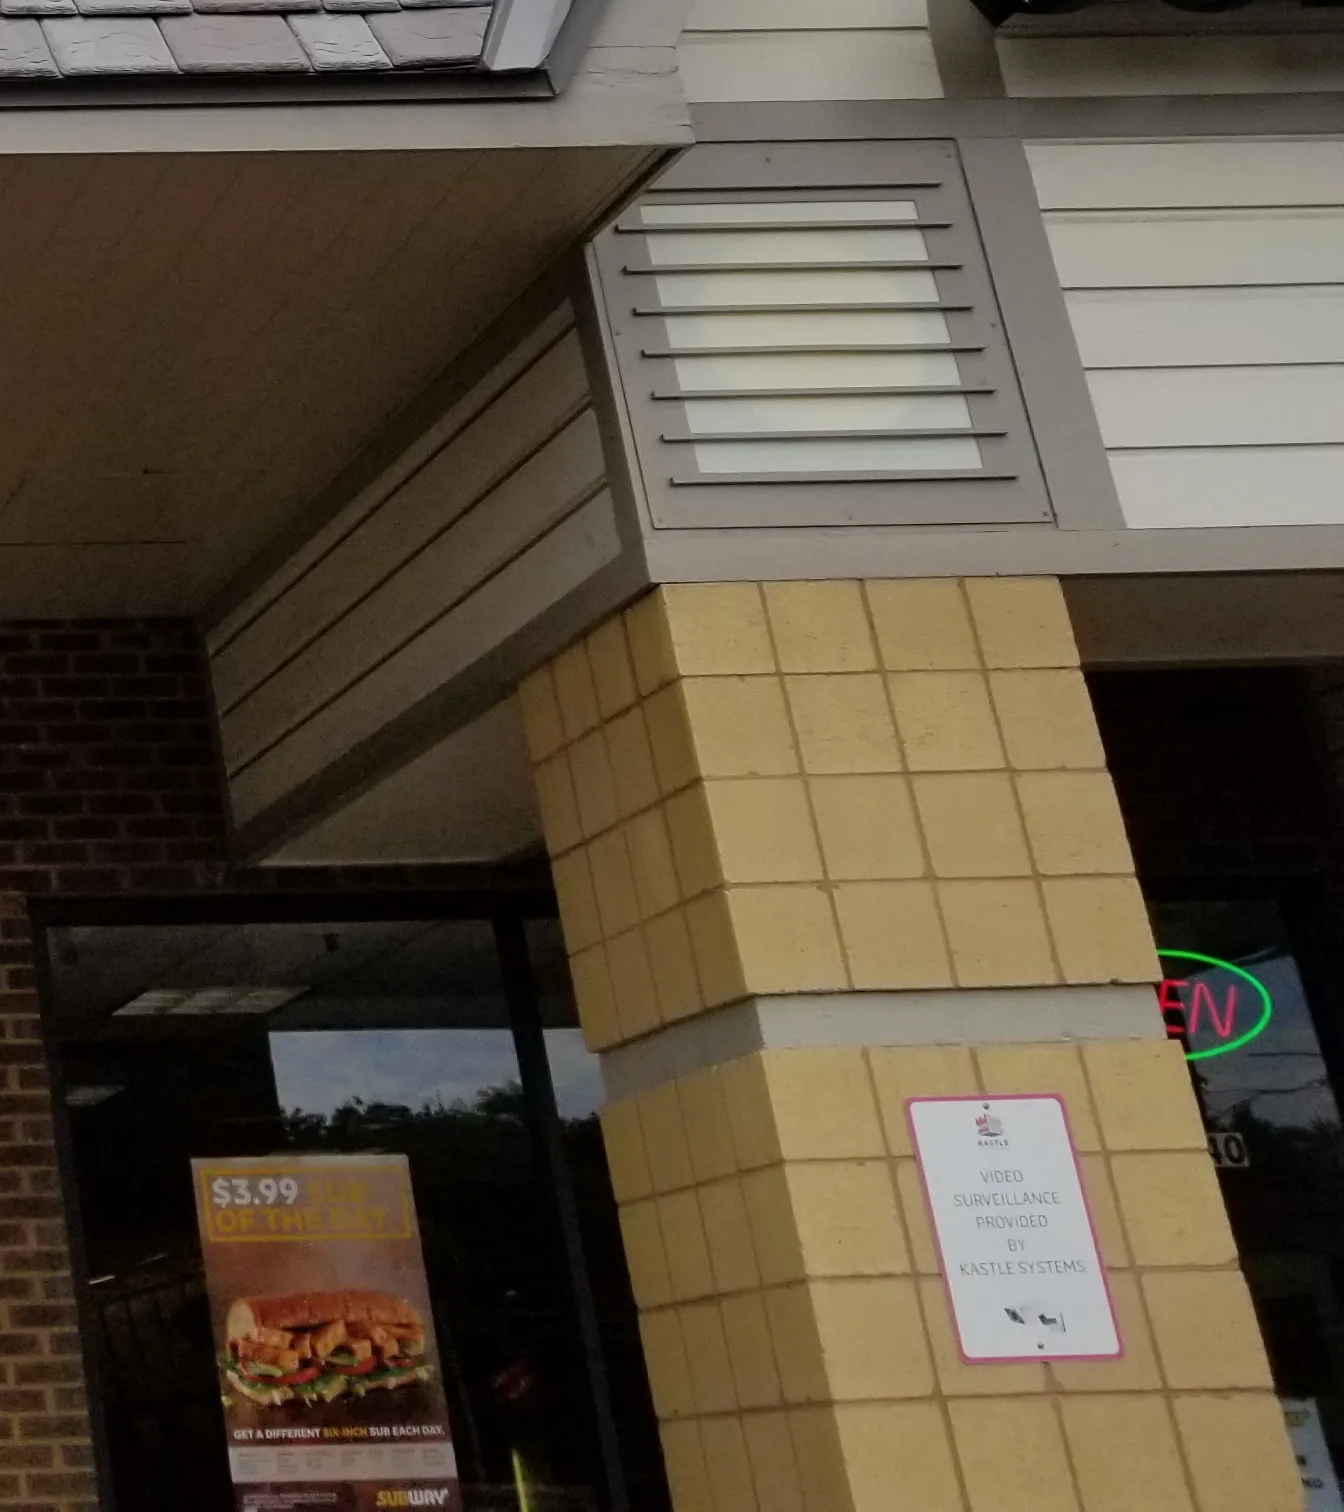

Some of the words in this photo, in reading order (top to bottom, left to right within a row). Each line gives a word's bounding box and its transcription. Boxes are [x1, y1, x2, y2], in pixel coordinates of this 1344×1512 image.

[980, 1169, 1024, 1184] VIDEO
[212, 1176, 299, 1209] $3.99
[953, 1191, 1061, 1207] SURVEILLANCE
[216, 1209, 255, 1232] OF
[260, 1208, 322, 1231] THE
[976, 1214, 1048, 1229] PROVIDED
[1008, 1238, 1026, 1252] BY
[959, 1261, 1015, 1276] KASTLE
[1018, 1259, 1087, 1274] SYSTEMS
[234, 1429, 254, 1440] GET
[255, 1429, 264, 1440] A
[265, 1427, 321, 1439] DIFFERENT
[369, 1426, 391, 1437] SUB
[392, 1426, 420, 1437] EACH
[376, 1487, 448, 1507] SUBWAY
